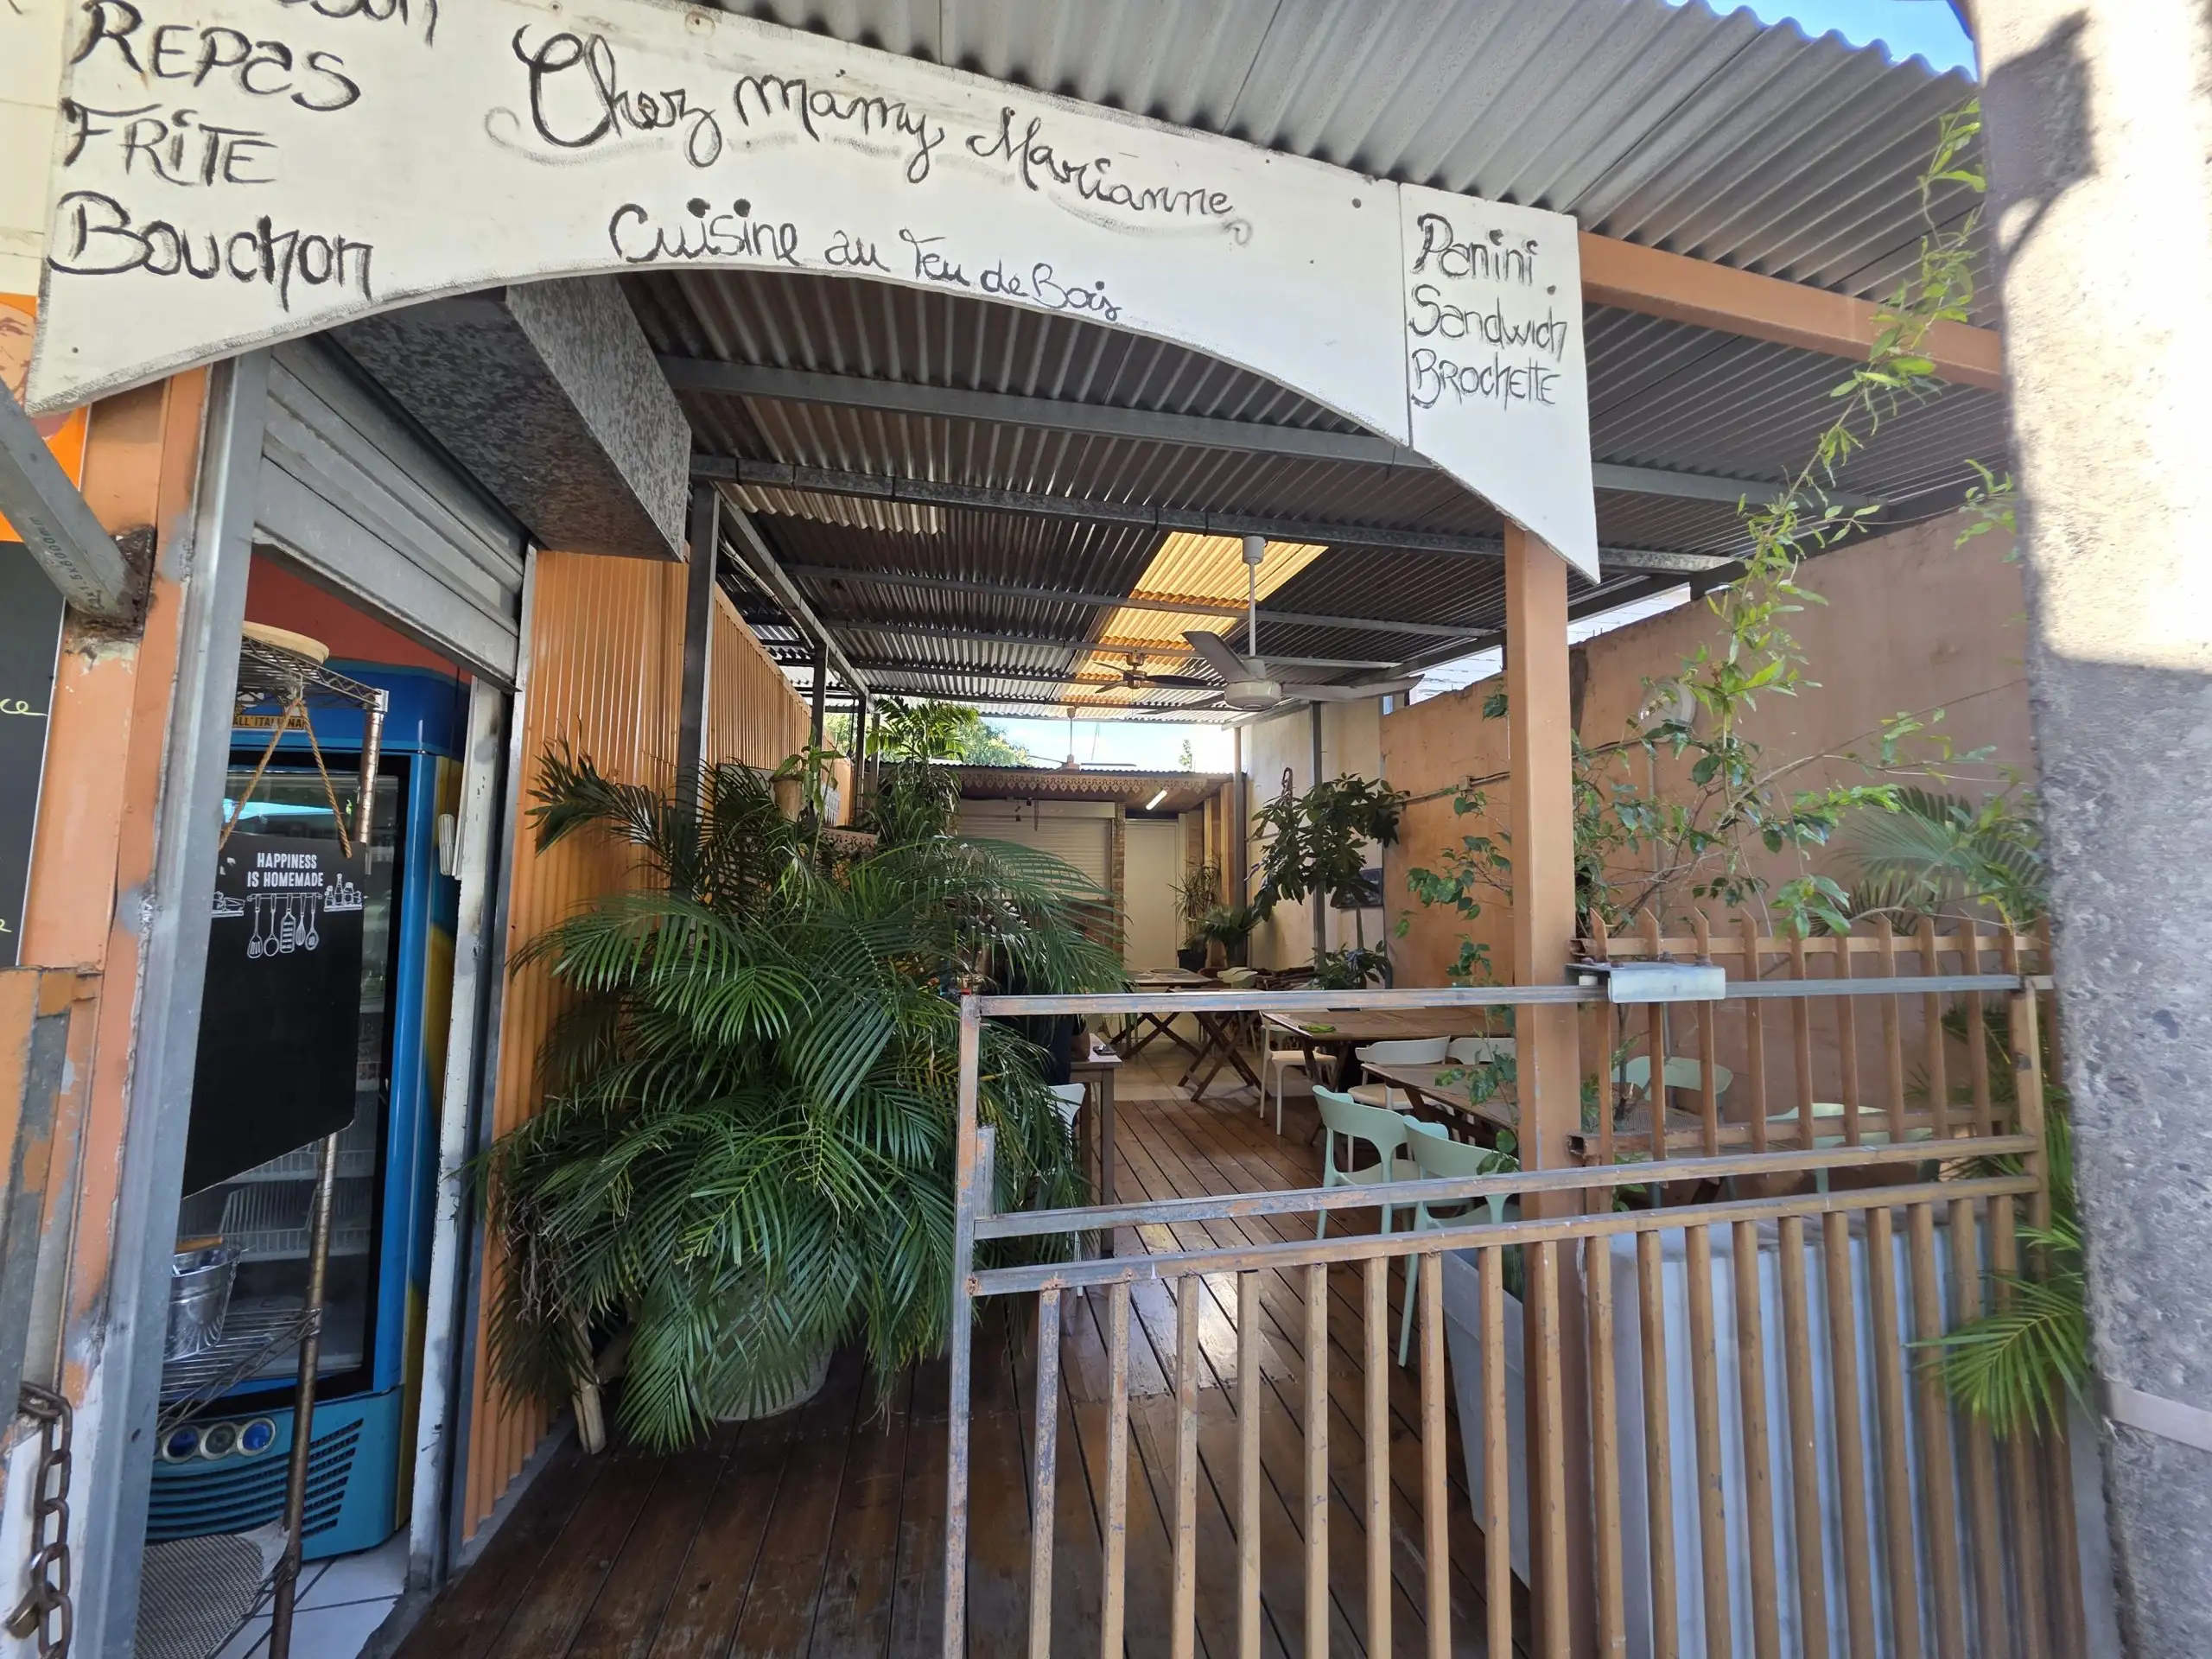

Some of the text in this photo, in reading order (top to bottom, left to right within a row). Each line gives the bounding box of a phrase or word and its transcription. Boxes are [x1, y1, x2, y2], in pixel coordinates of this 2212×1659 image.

[512, 23, 723, 169] Chez
[965, 106, 1233, 216] Marianne
[48, 190, 374, 313] Bouchon
[608, 197, 803, 264] Cuisine
[824, 229, 892, 273] au
[980, 258, 1029, 295] de
[1032, 262, 1122, 321] Bois
[1411, 213, 1539, 286] Panini
[1408, 283, 1568, 364] Sandwich
[246, 871, 325, 887] IS HOMEMADE
[256, 852, 318, 869] HAPPINESS
